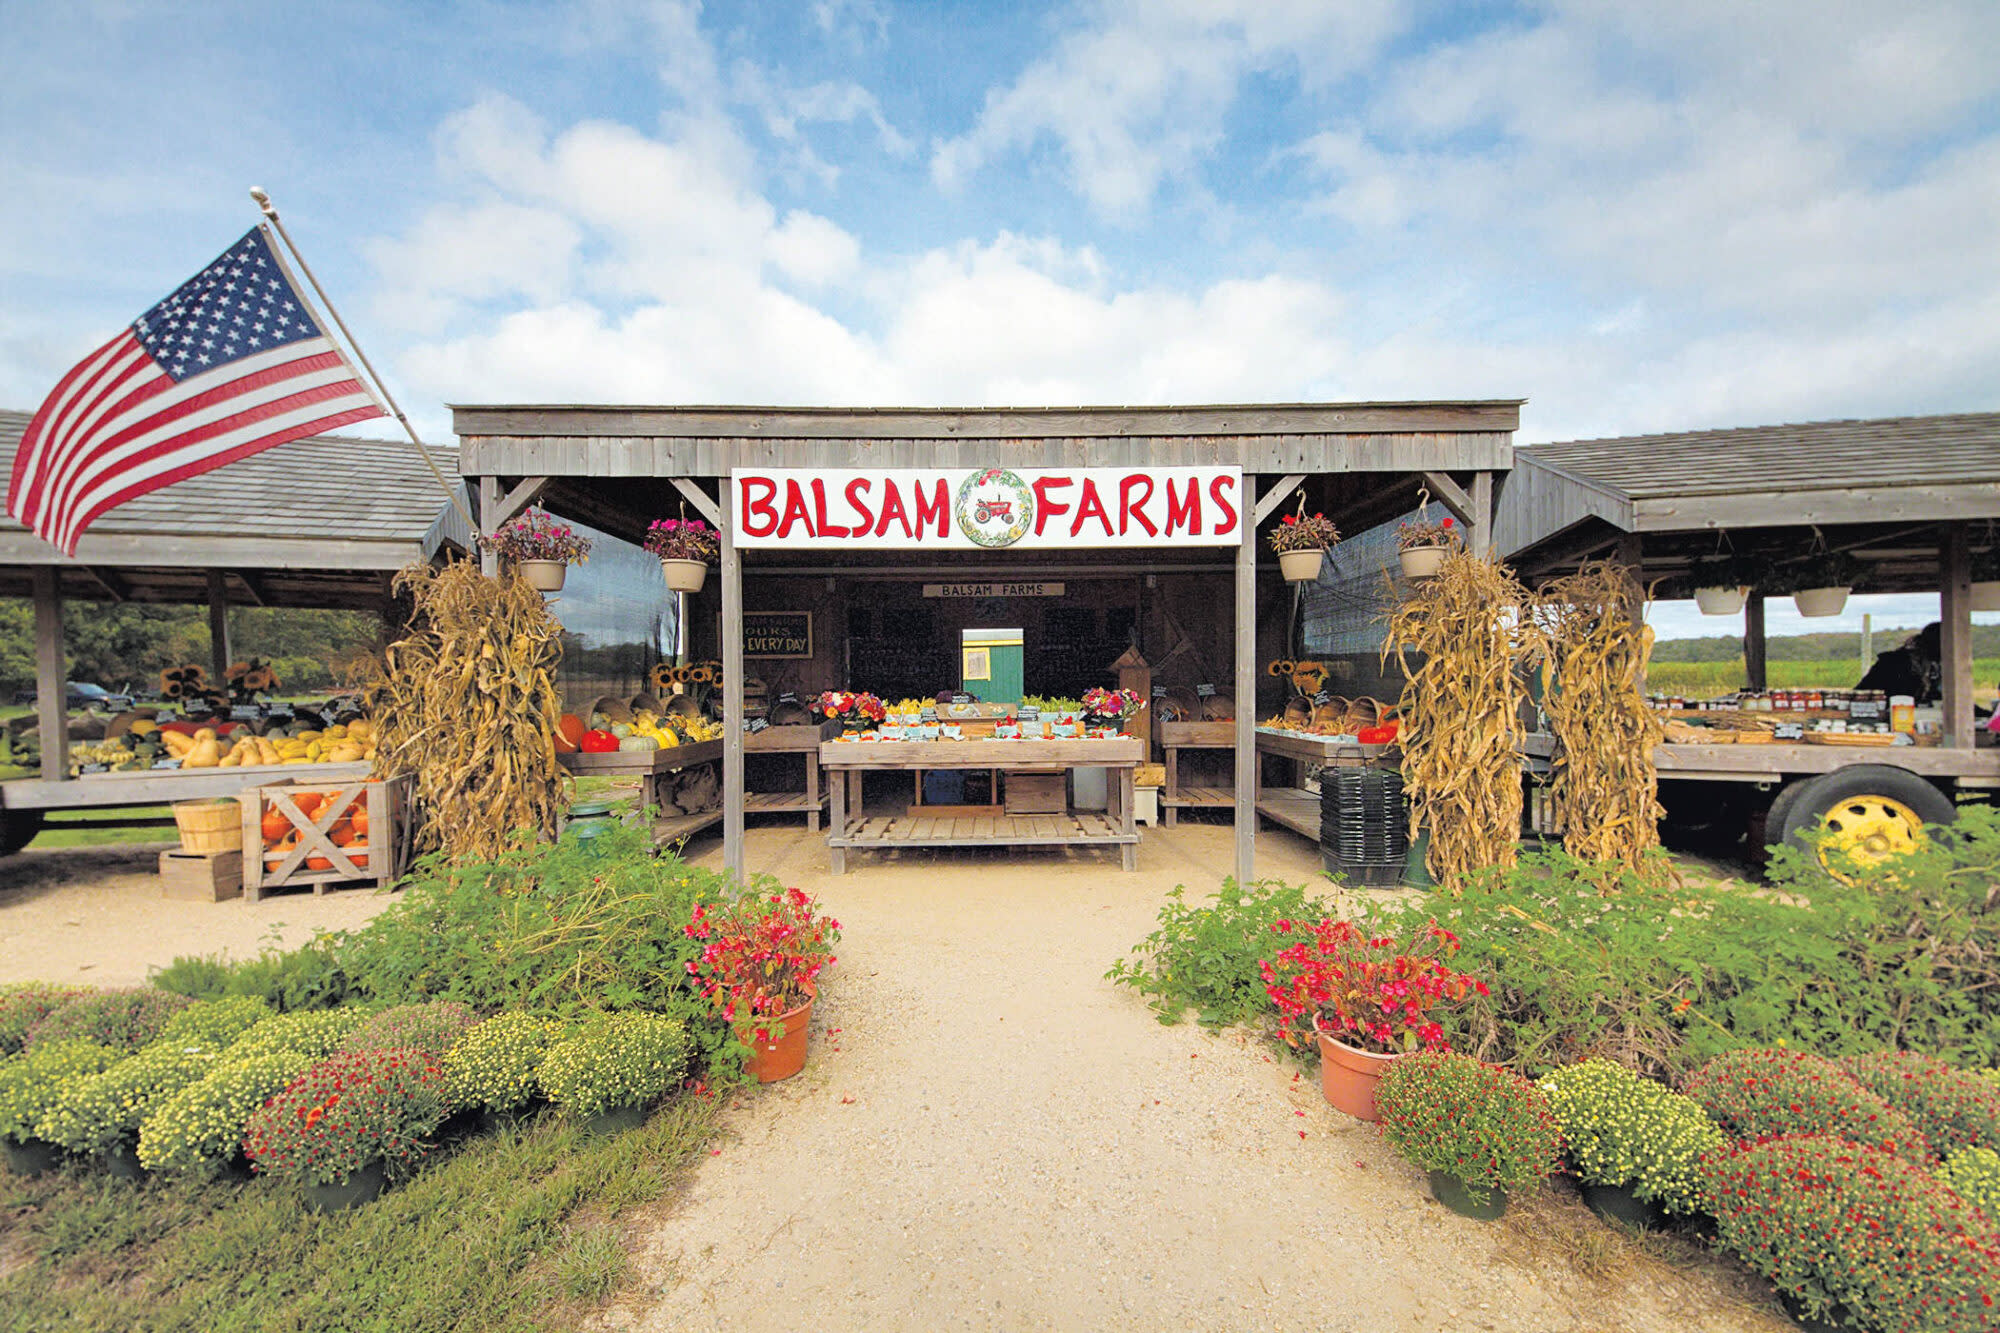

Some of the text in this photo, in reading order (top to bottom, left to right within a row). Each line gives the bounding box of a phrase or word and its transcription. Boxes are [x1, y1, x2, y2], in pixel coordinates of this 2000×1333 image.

[739, 474, 1238, 541] BALSAM FARMS
[942, 584, 1045, 596] BALSAM FARMS
[745, 627, 791, 636] OURS
[747, 637, 784, 651] EVERY
[786, 638, 807, 651] DAY
